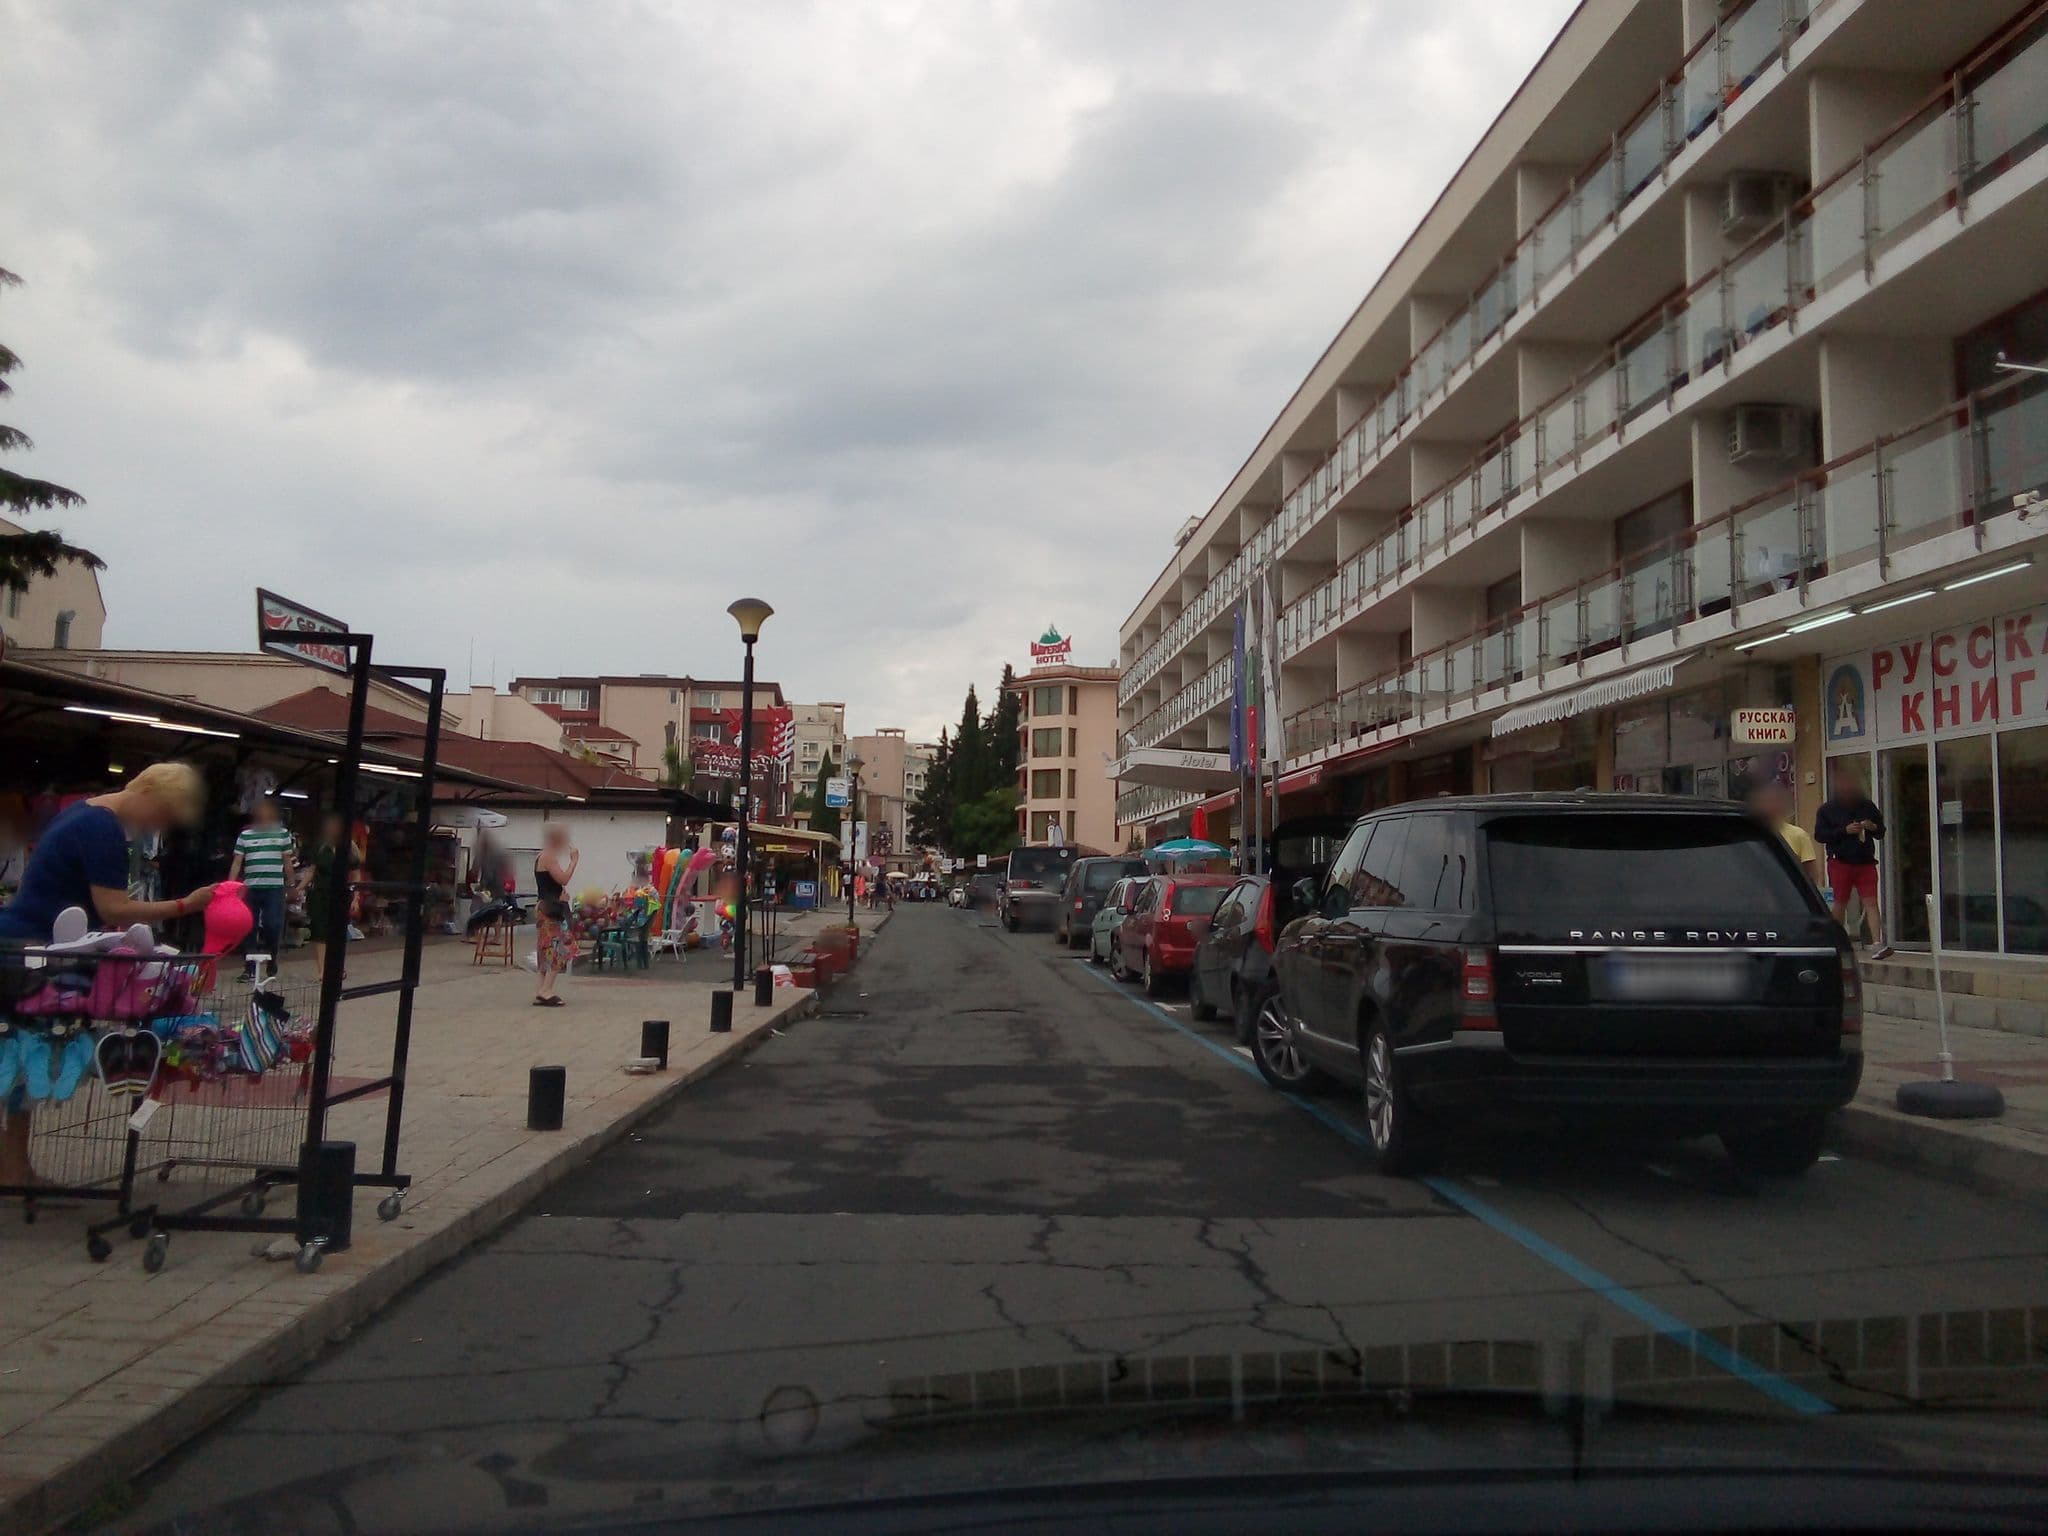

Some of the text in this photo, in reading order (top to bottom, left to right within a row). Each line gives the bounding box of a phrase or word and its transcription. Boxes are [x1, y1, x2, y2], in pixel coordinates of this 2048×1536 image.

[1872, 614, 2048, 690] РУССК
[1036, 654, 1066, 664] HOTEL
[1902, 669, 2048, 733] КНИГ
[1740, 712, 1795, 723] РУССКАЯ
[1748, 728, 1787, 740] КНИГА
[1180, 754, 1217, 769] Hotel
[1570, 931, 1778, 941] RANGE ROVER
